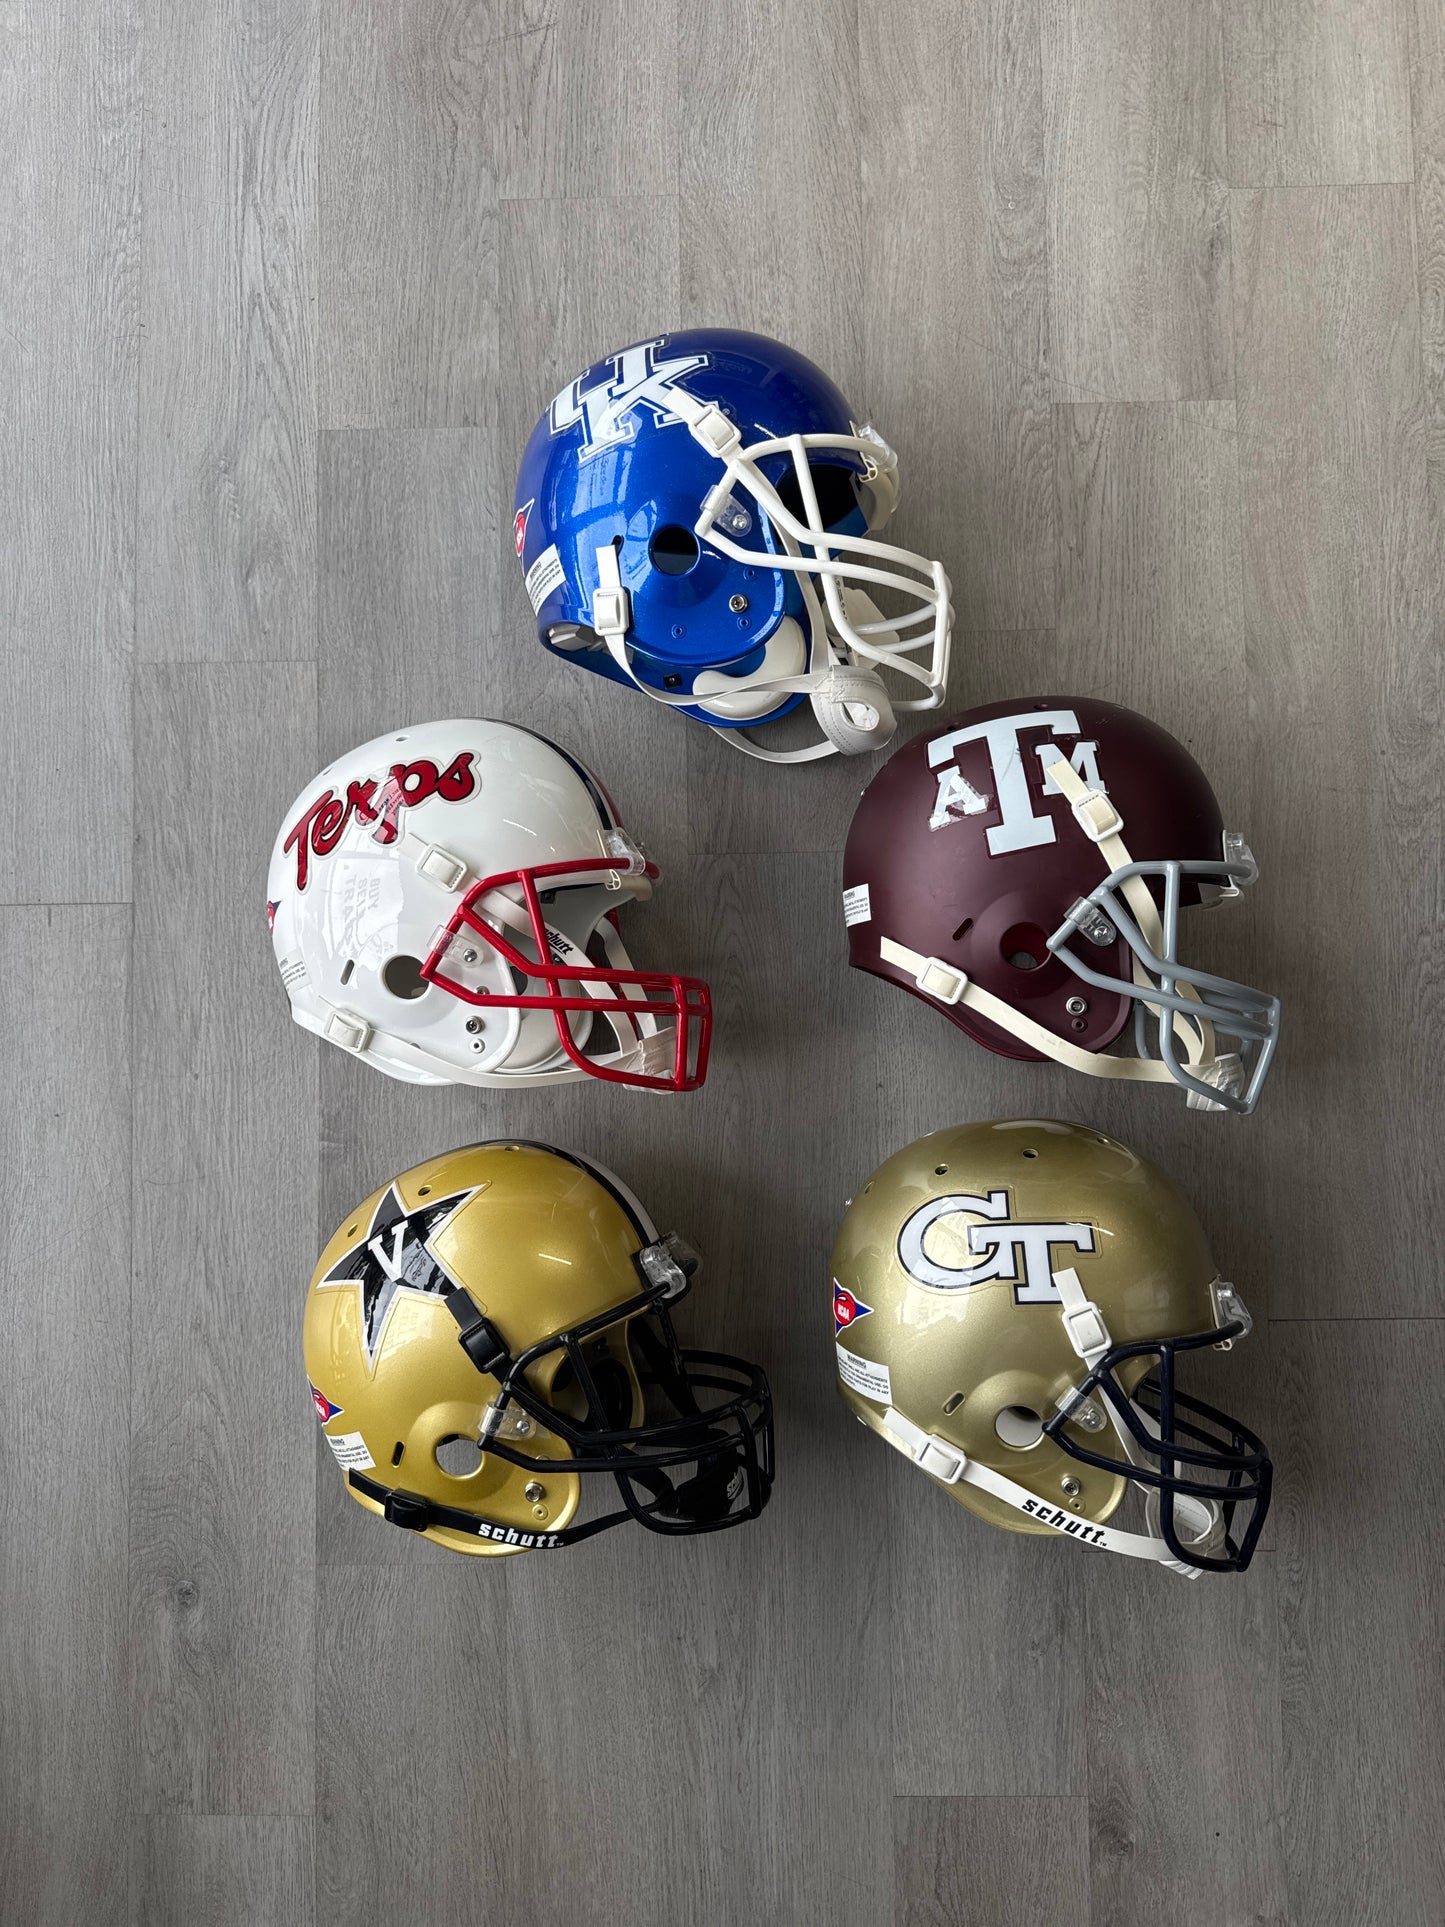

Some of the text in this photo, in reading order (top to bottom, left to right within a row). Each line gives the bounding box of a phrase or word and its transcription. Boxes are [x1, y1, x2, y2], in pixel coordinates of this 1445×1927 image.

[284, 752, 475, 890] Terps
[545, 928, 574, 955] chutt
[368, 1220, 408, 1282] V
[897, 1190, 1096, 1305] GT
[478, 1523, 559, 1548] schutt
[1021, 1499, 1106, 1543] schutt
